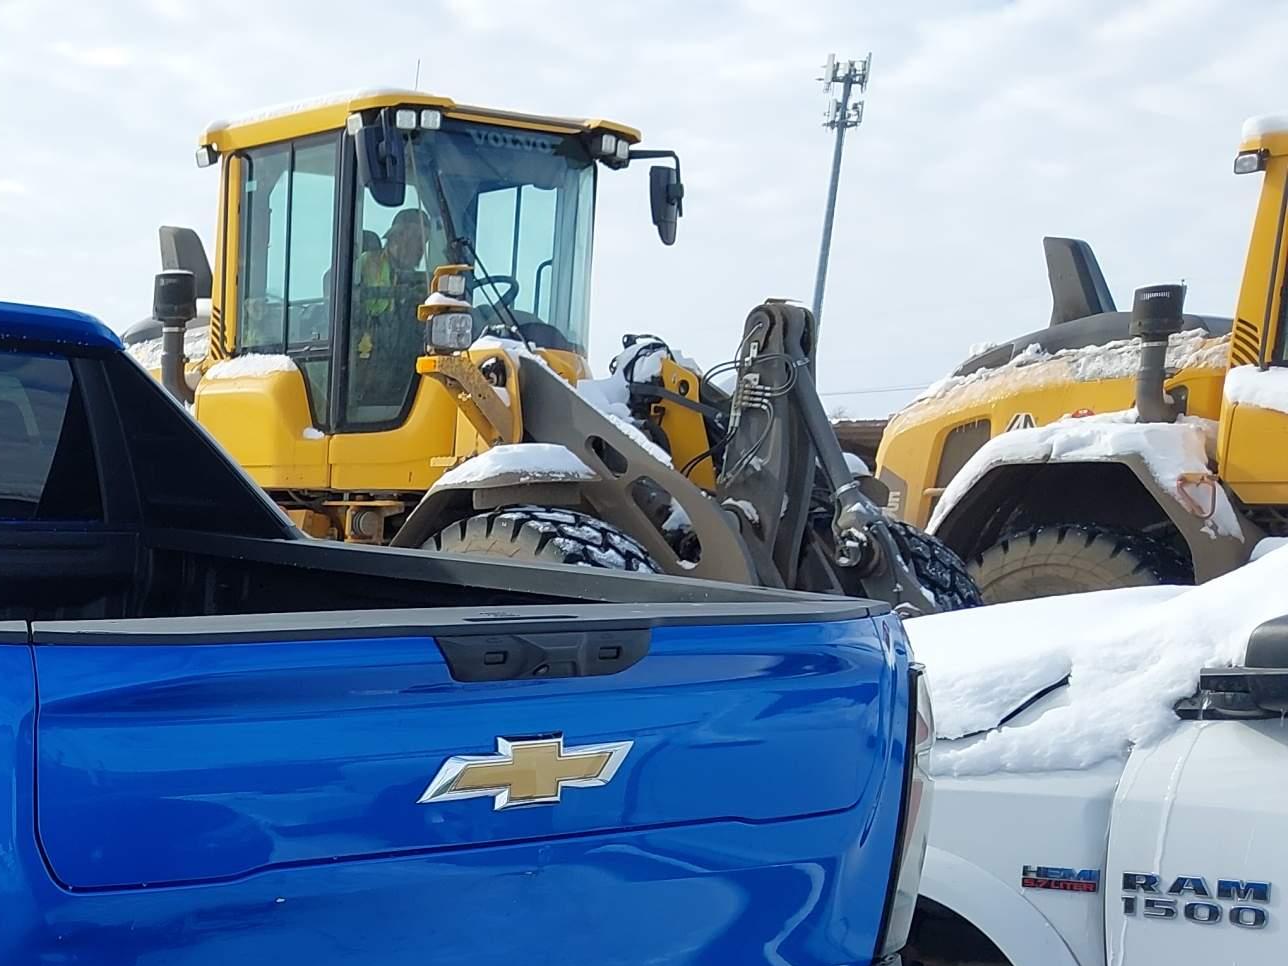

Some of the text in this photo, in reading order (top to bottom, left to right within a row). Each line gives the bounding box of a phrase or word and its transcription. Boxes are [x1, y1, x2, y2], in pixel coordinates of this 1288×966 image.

[465, 128, 552, 153] VOLVO
[1022, 864, 1100, 881] HEMI
[1052, 879, 1096, 892] LITER
[1122, 871, 1272, 903] RAM
[1121, 895, 1269, 929] 1500
